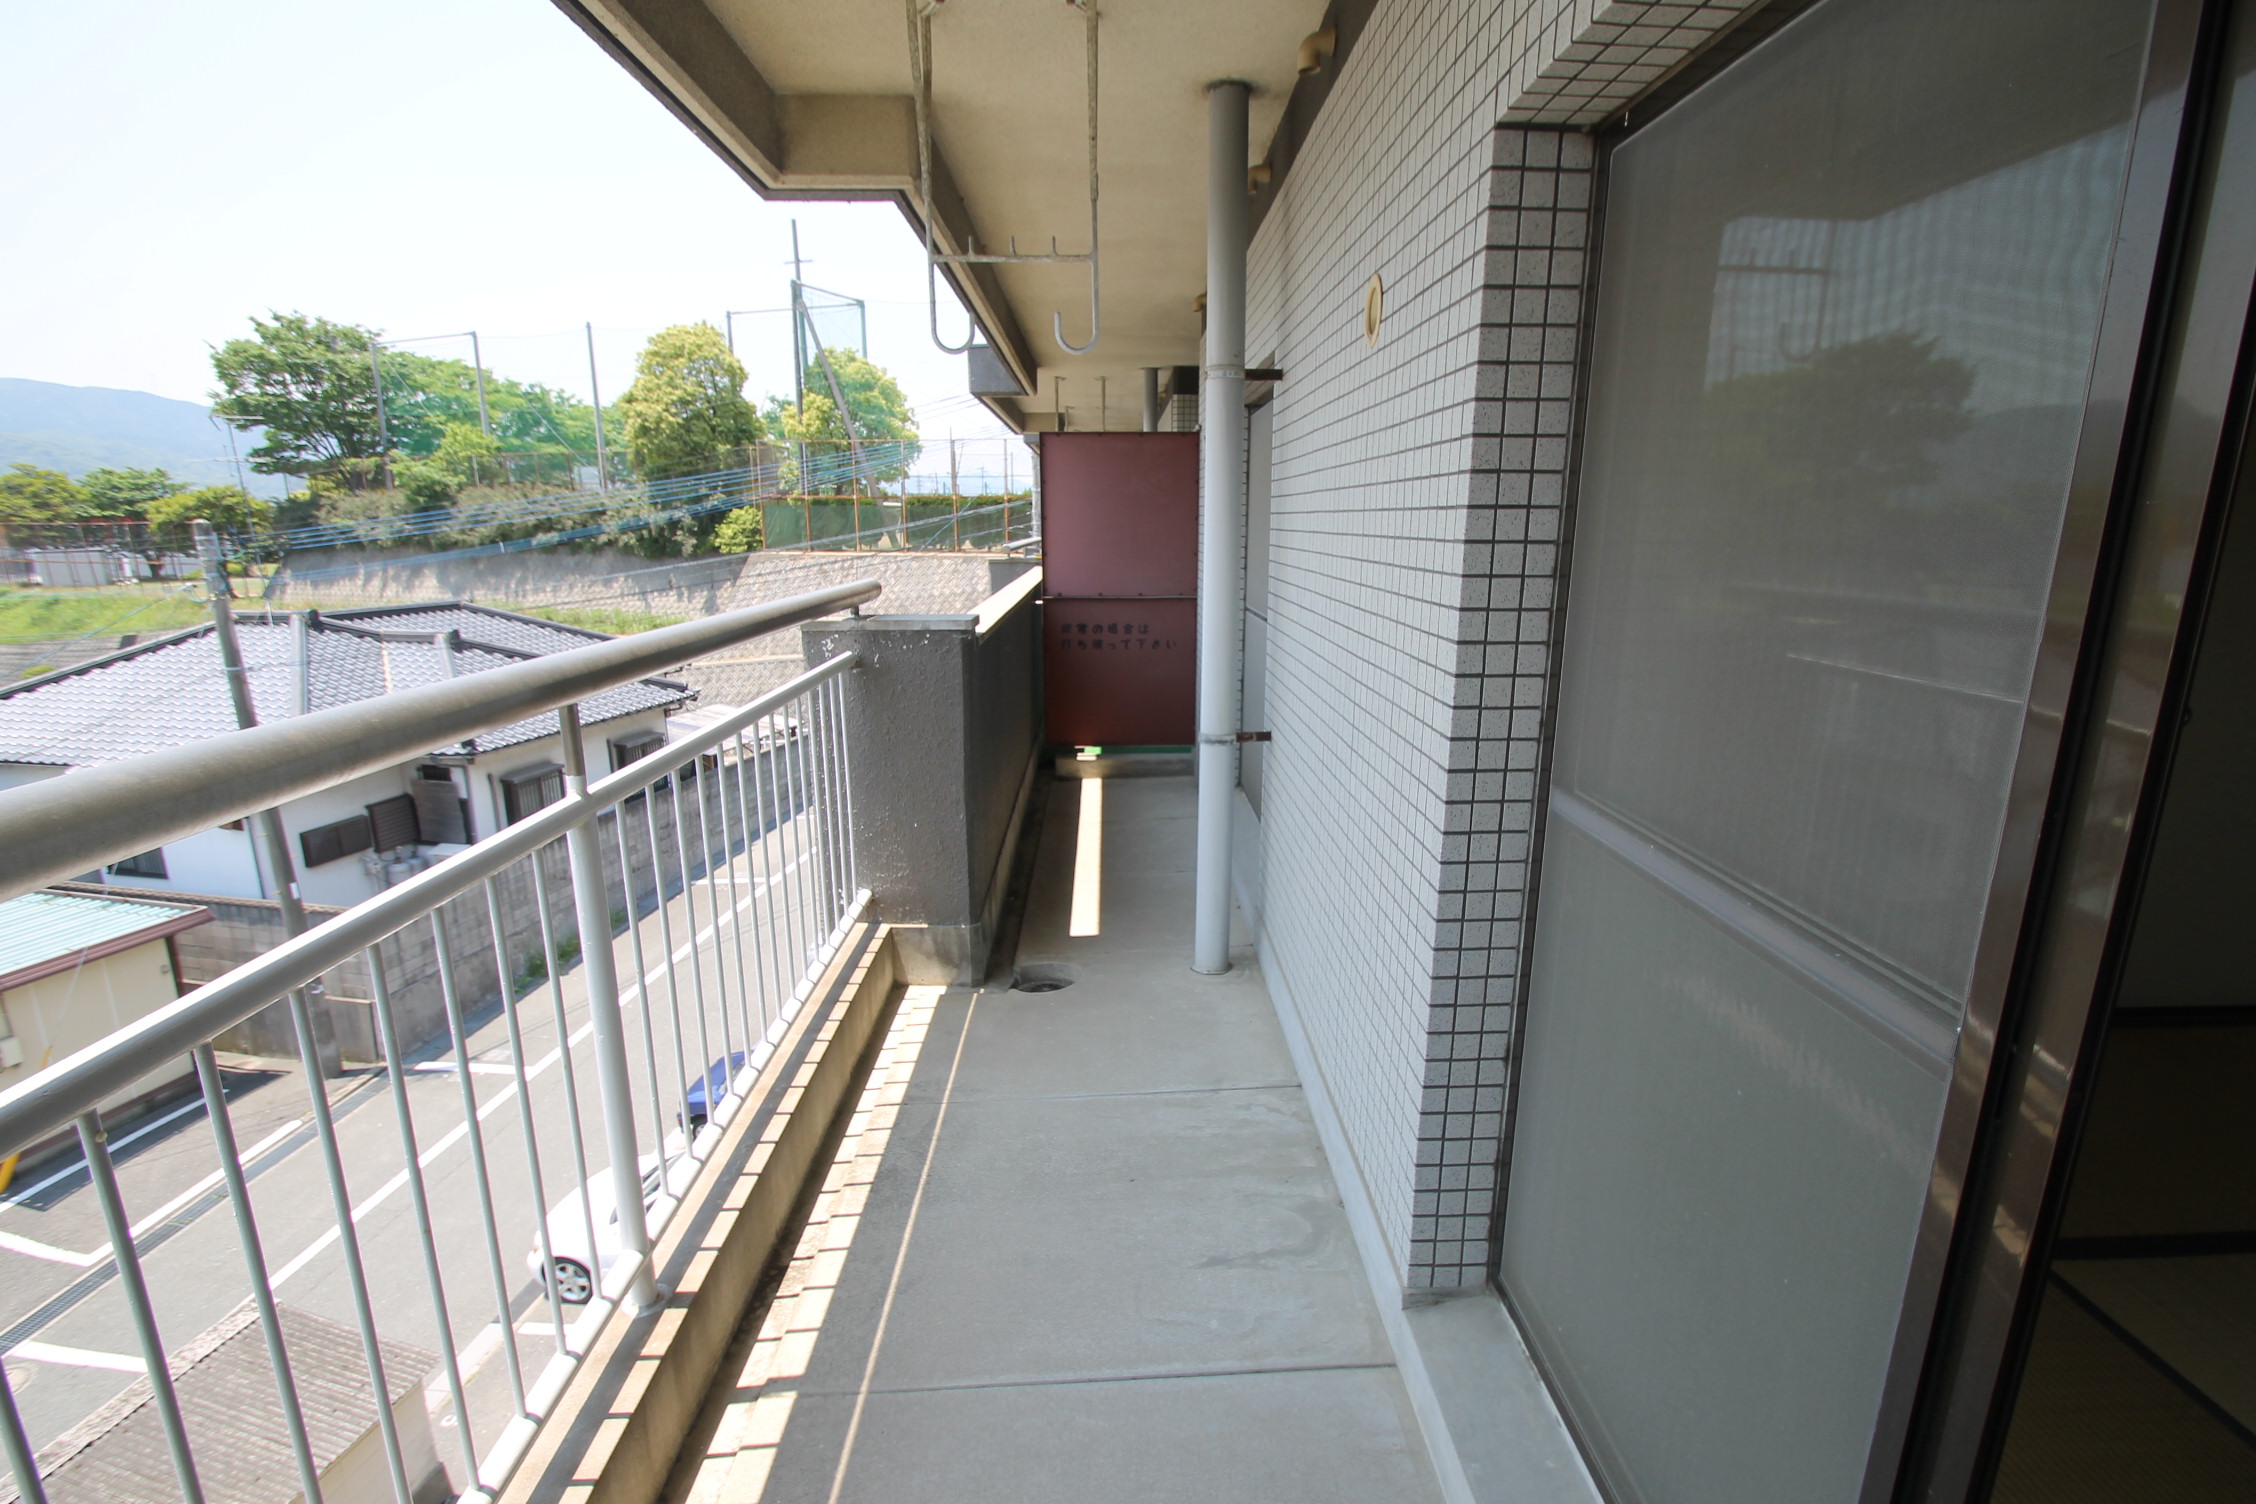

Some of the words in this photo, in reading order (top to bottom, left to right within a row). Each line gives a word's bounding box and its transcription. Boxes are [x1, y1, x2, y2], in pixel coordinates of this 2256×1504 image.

[1061, 623, 1149, 635] 非常の場合は
